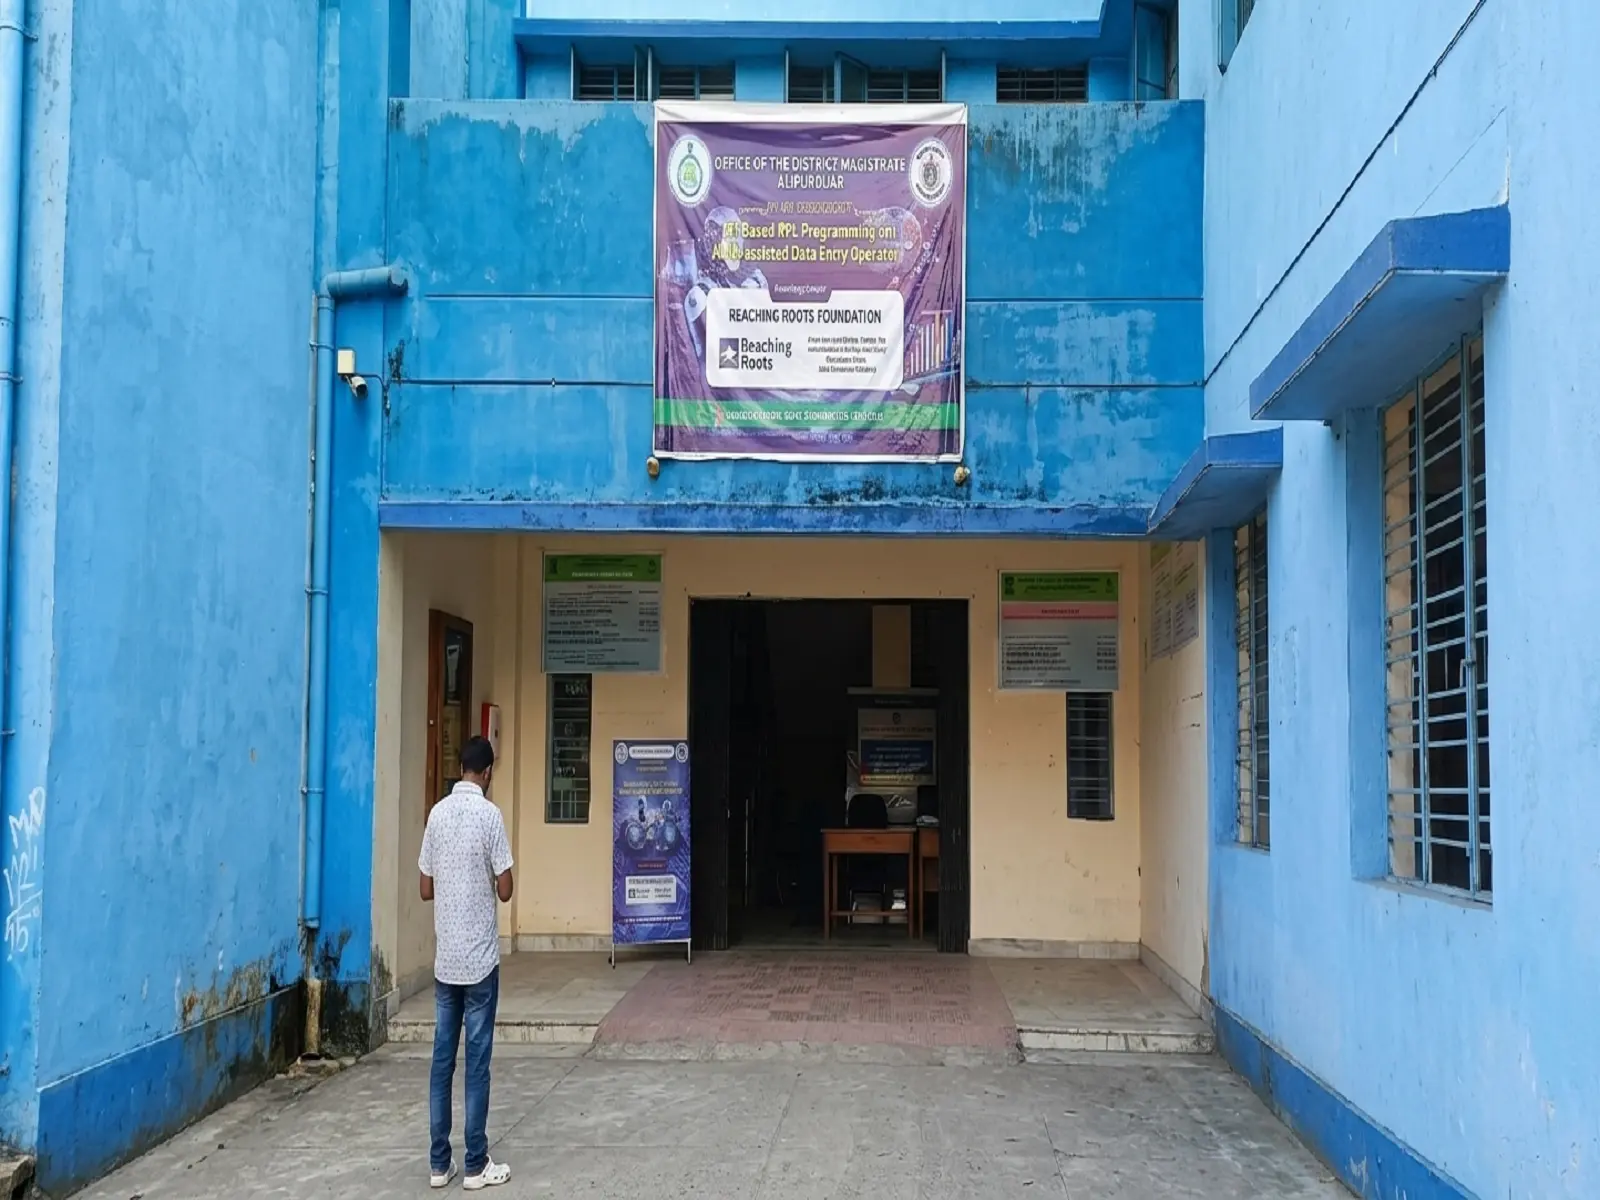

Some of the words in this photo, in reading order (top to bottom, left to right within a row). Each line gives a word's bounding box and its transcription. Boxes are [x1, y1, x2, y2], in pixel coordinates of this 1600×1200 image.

[714, 156, 751, 170] OFFICE
[753, 156, 767, 170] OF
[769, 157, 789, 171] THE
[791, 157, 838, 172] DISTRICT
[840, 158, 906, 172] MAGISTRATE
[741, 222, 774, 238] Based
[791, 245, 817, 261] Data
[729, 308, 780, 324] REACHING
[782, 308, 815, 324] ROOTS
[817, 309, 882, 324] FOUNDATION
[741, 354, 773, 371] Roots
